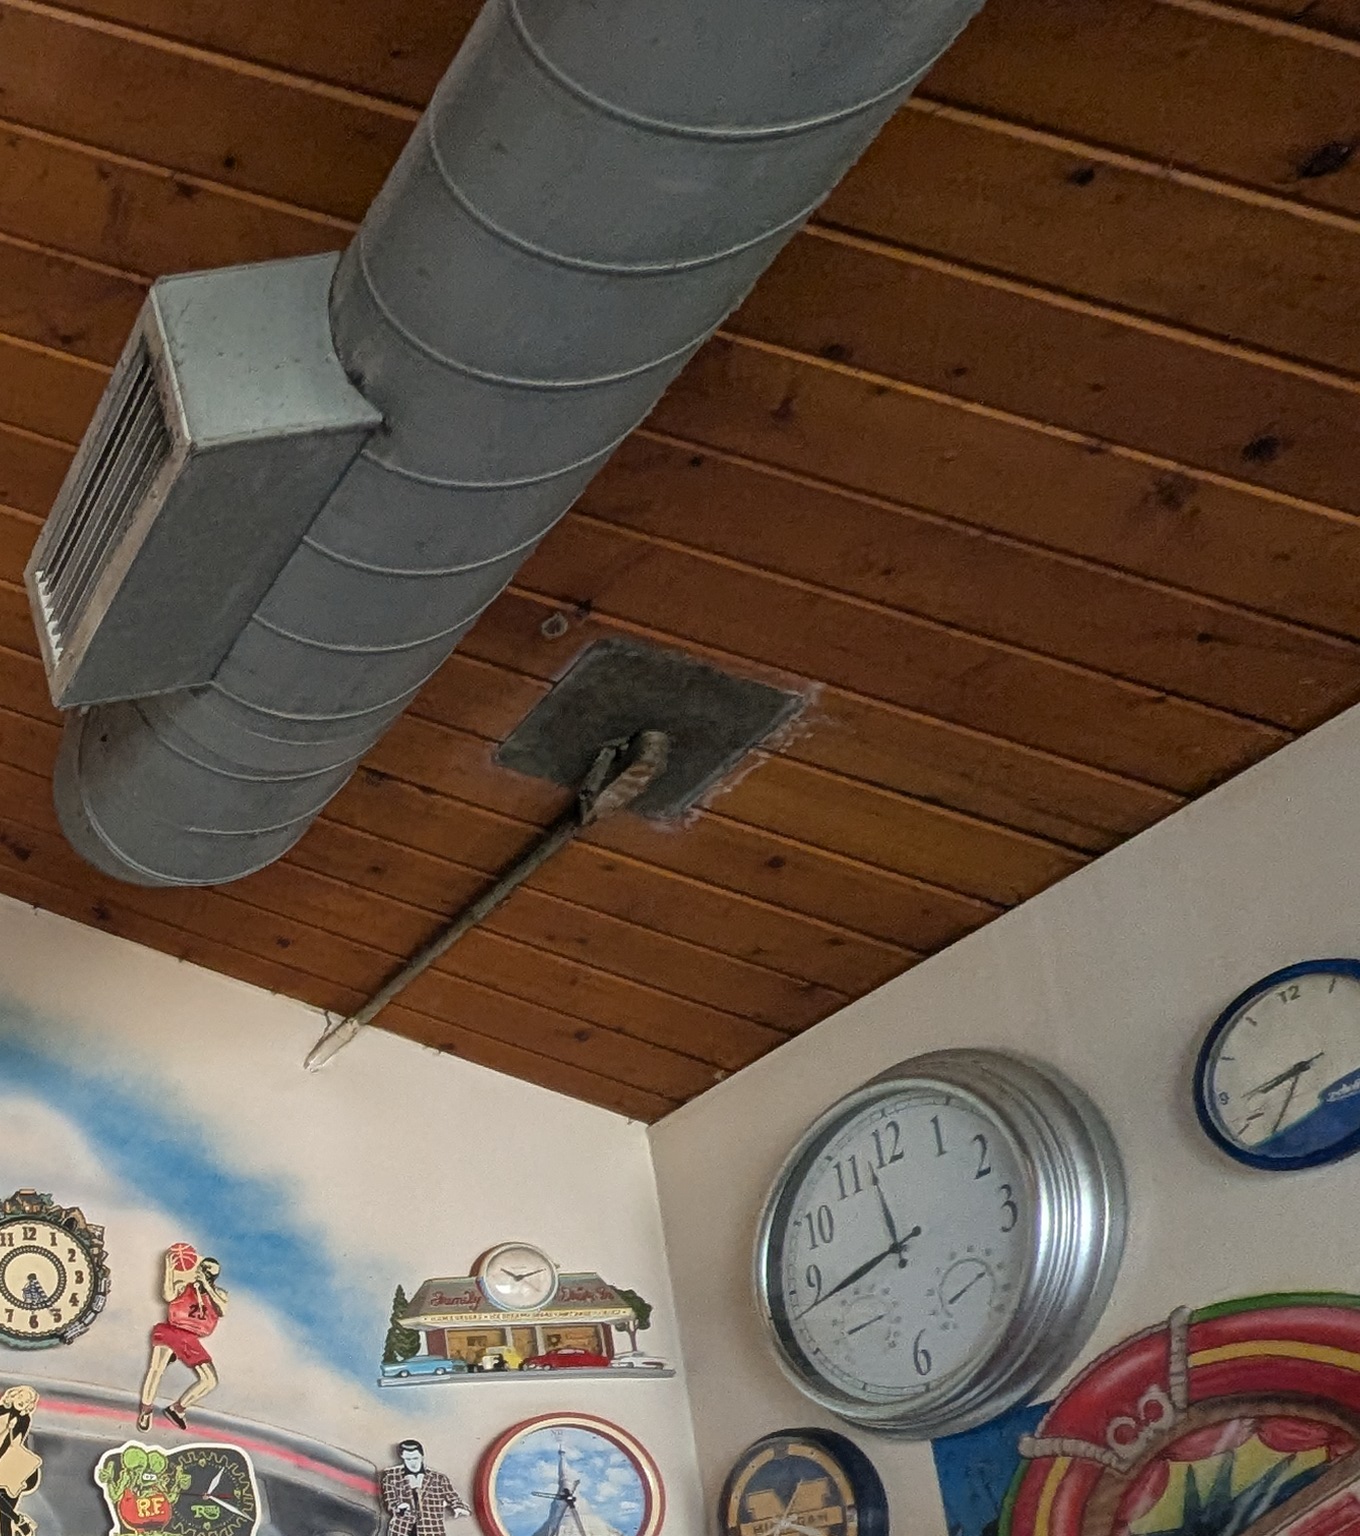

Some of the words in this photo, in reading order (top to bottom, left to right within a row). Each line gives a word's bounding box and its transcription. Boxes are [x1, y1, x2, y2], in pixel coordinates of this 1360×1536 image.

[1277, 985, 1301, 1004] 12
[870, 1121, 904, 1170] 12
[930, 1115, 948, 1157] 1
[973, 1134, 992, 1180] 2
[832, 1155, 863, 1201] 11
[999, 1184, 1018, 1232] 3
[22, 1227, 37, 1240] 12
[805, 1205, 834, 1250] 10
[0, 1233, 14, 1247] 11
[50, 1232, 57, 1246] 1
[68, 1249, 76, 1262] 2
[75, 1271, 84, 1284] 3
[806, 1264, 823, 1306] 9
[69, 1293, 79, 1306] 4
[5, 1309, 14, 1323] 7
[29, 1315, 38, 1329] 6
[913, 1328, 931, 1376] 6
[137, 1498, 165, 1517] R.F.
